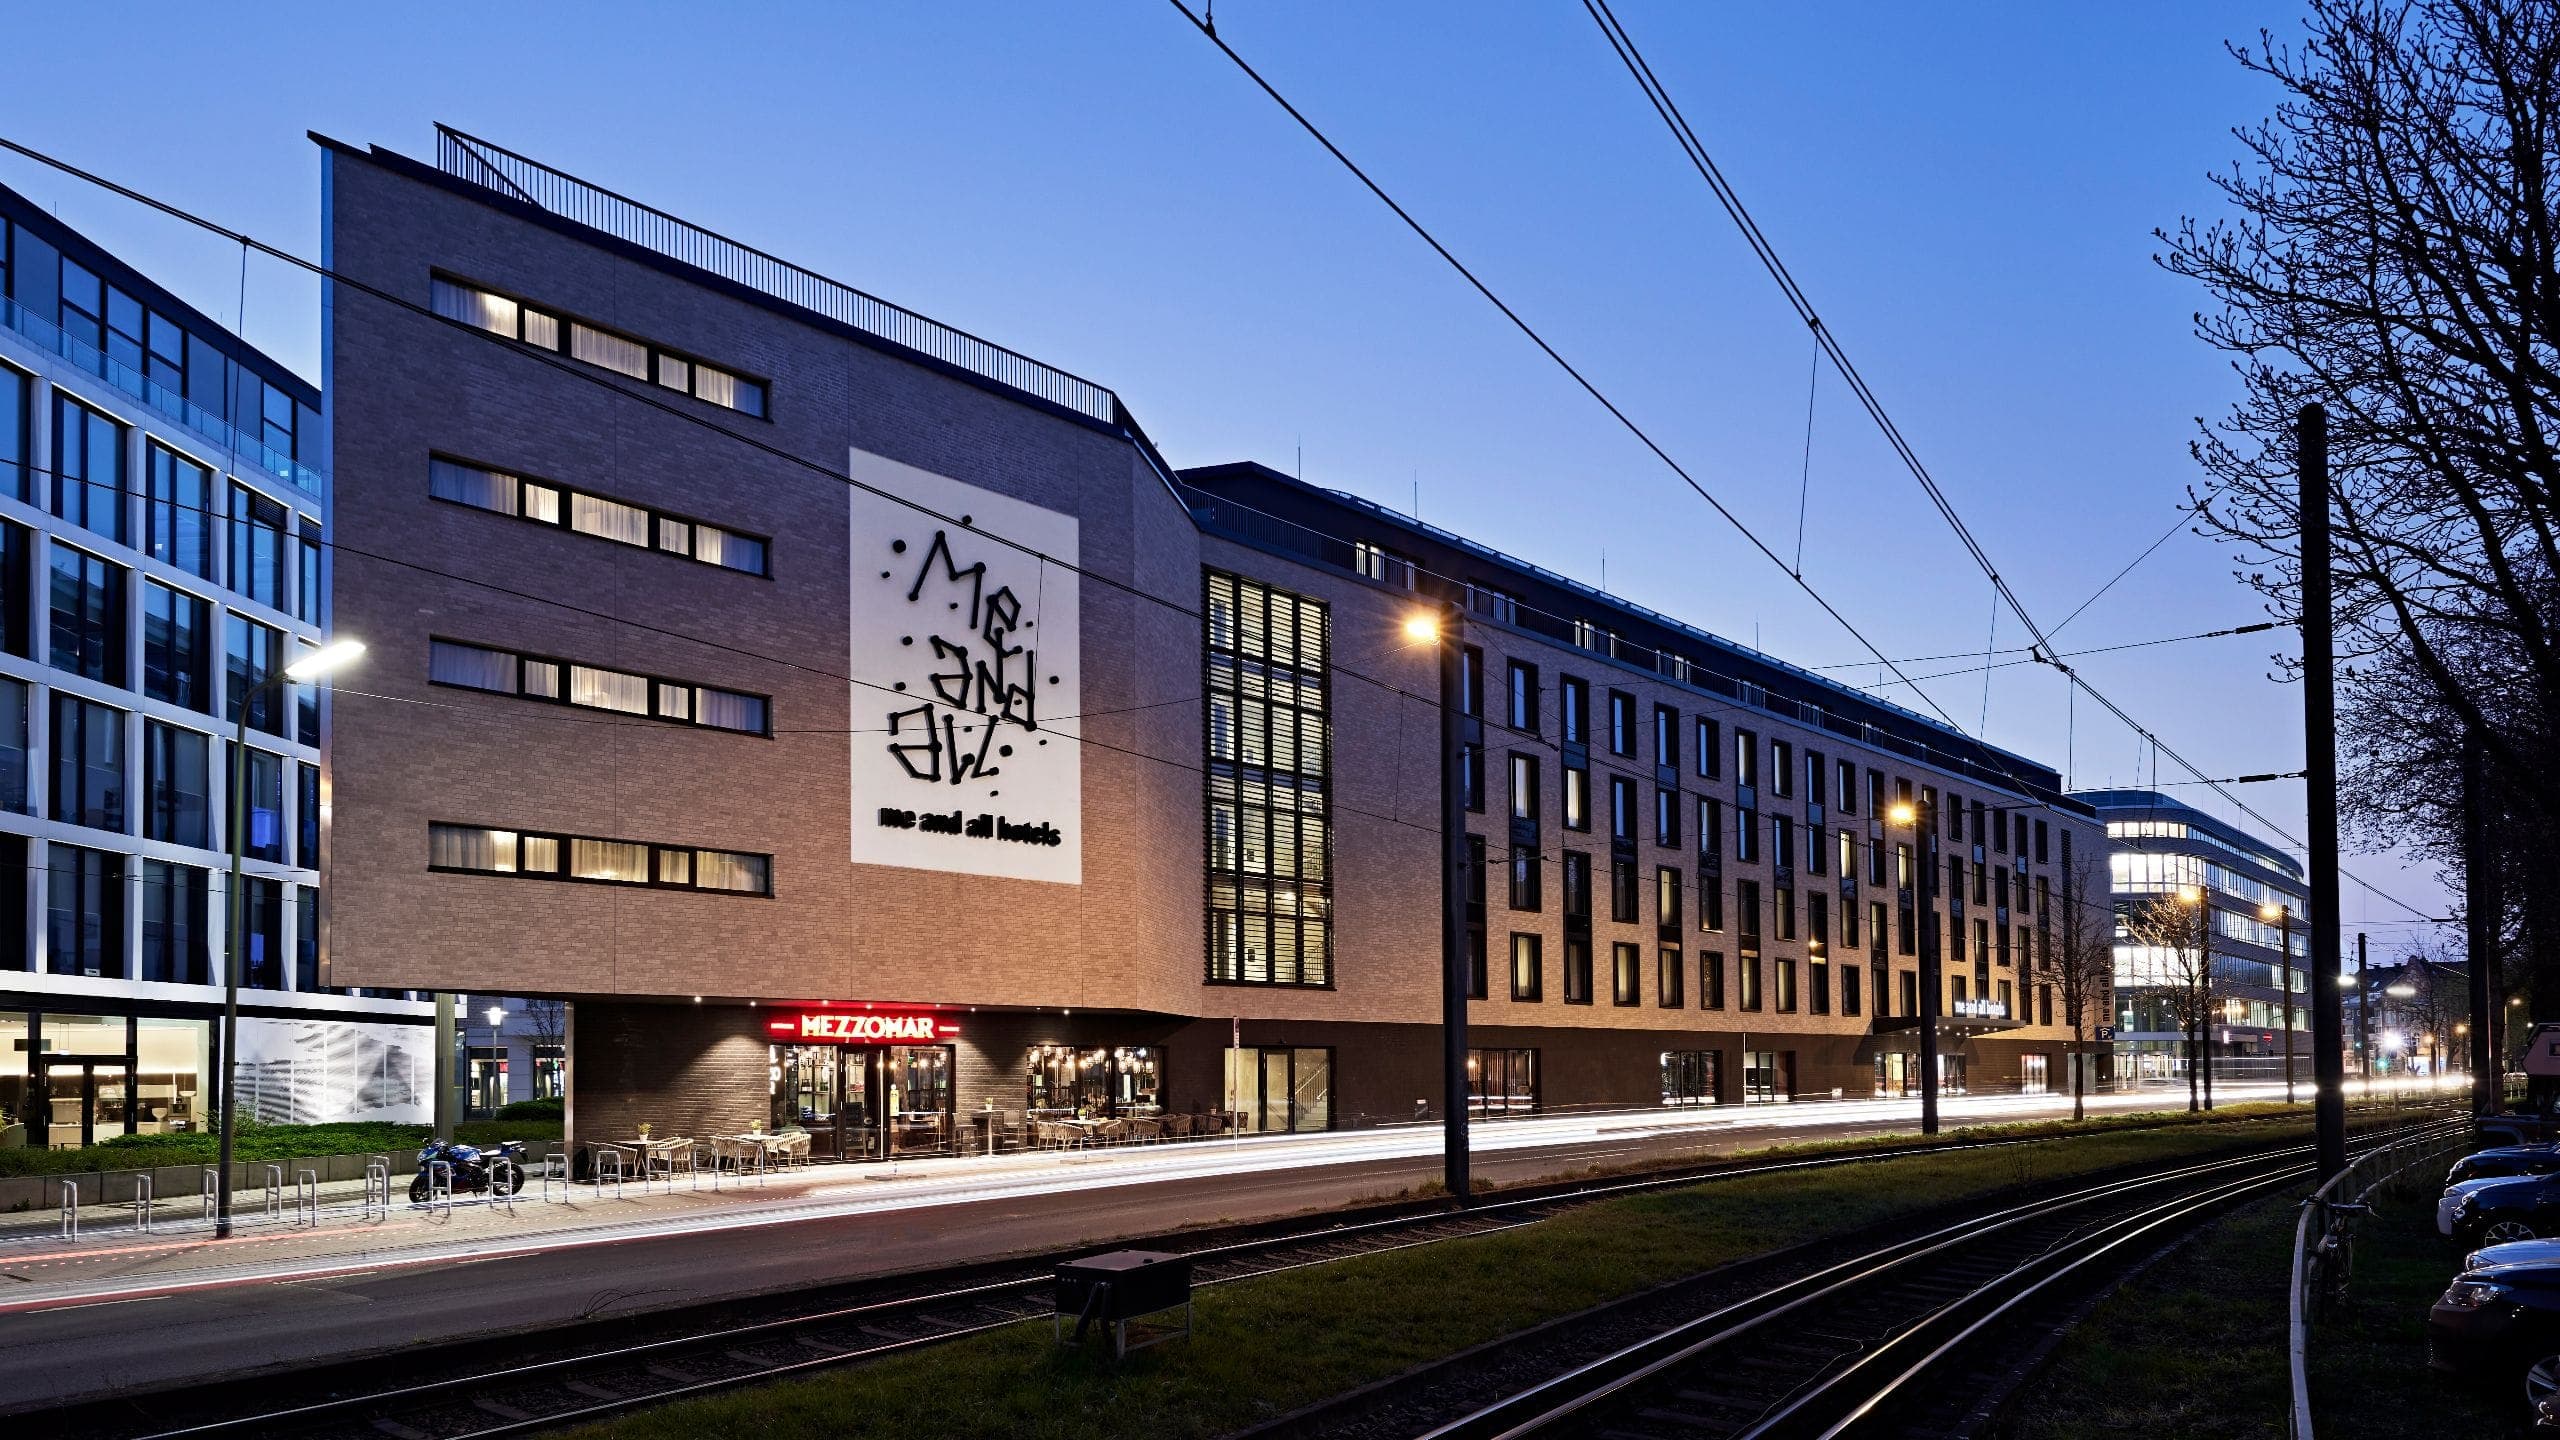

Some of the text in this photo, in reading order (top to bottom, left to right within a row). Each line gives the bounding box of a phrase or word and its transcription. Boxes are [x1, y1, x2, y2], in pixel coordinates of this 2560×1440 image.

[878, 807, 1062, 848] me and all hotels
[801, 1014, 936, 1039] MEZZOMAR
[2102, 1008, 2110, 1022] me
